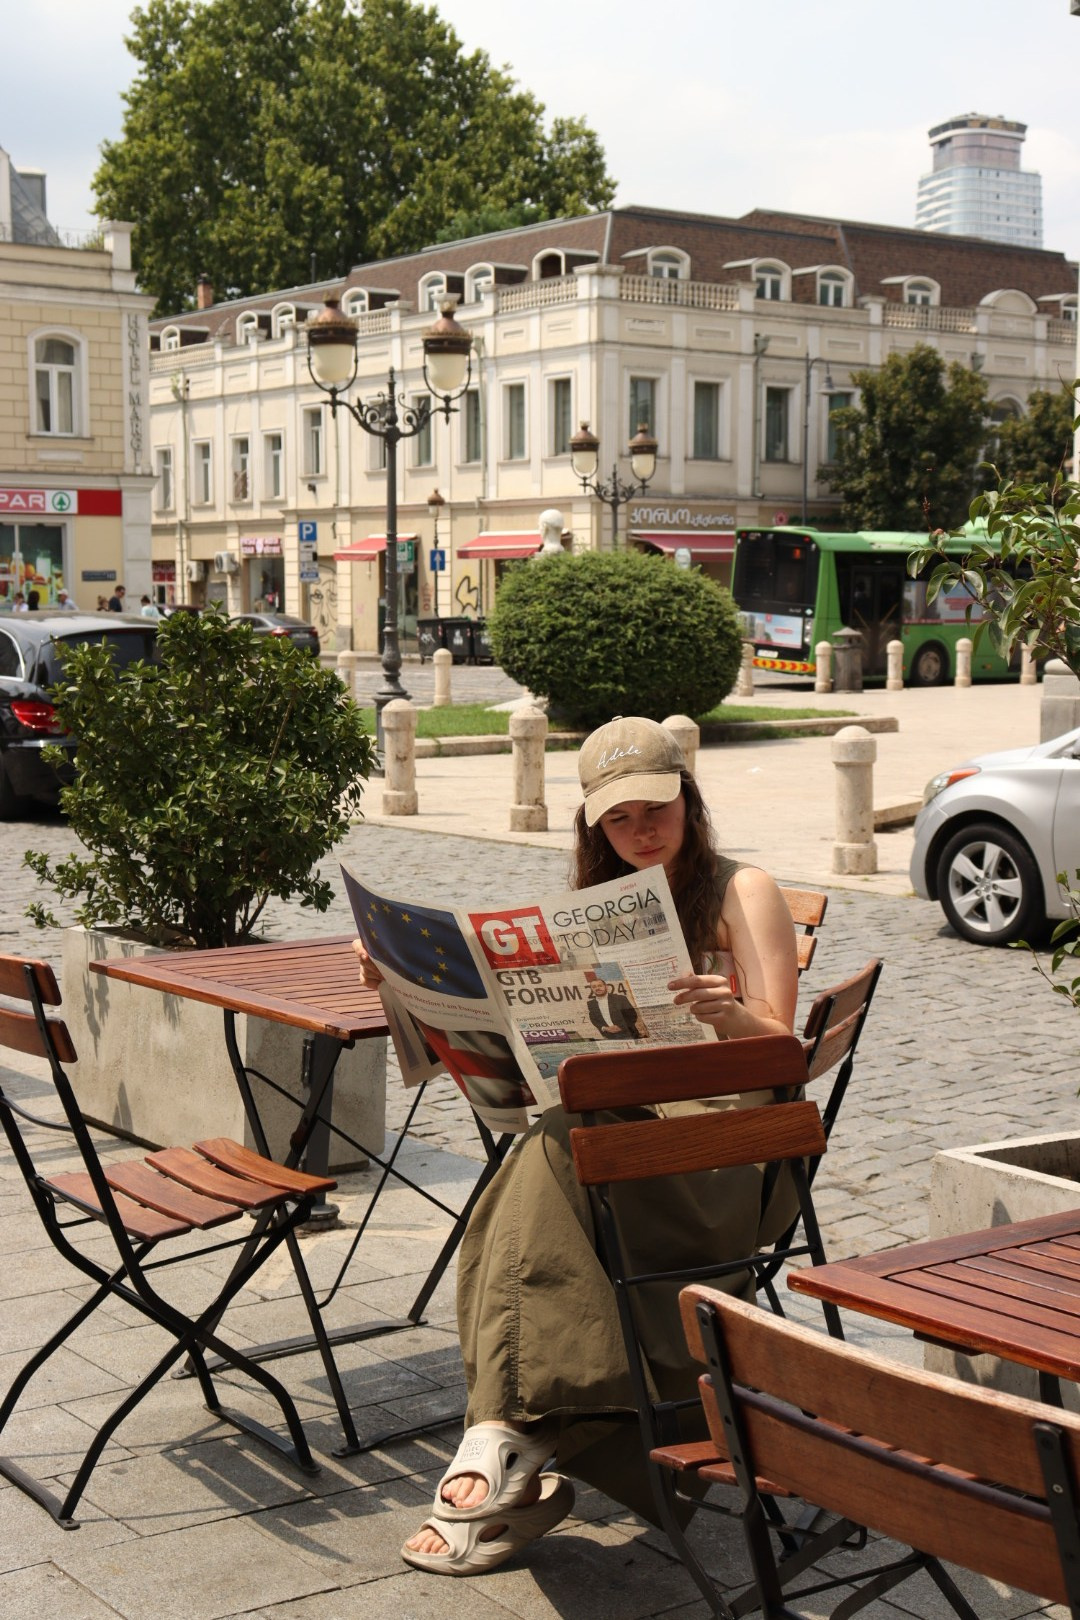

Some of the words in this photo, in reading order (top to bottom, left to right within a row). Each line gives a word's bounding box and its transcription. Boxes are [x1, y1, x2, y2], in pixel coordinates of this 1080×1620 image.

[302, 524, 314, 541] P
[596, 745, 642, 769] Adele
[553, 888, 661, 928] GEORGIA
[480, 915, 546, 957] GT
[559, 919, 638, 950] TODAY
[496, 969, 542, 986] GTB
[503, 985, 582, 1006] FORUM
[522, 1029, 565, 1038] FOCUS
[529, 1018, 575, 1029] PROVISION
